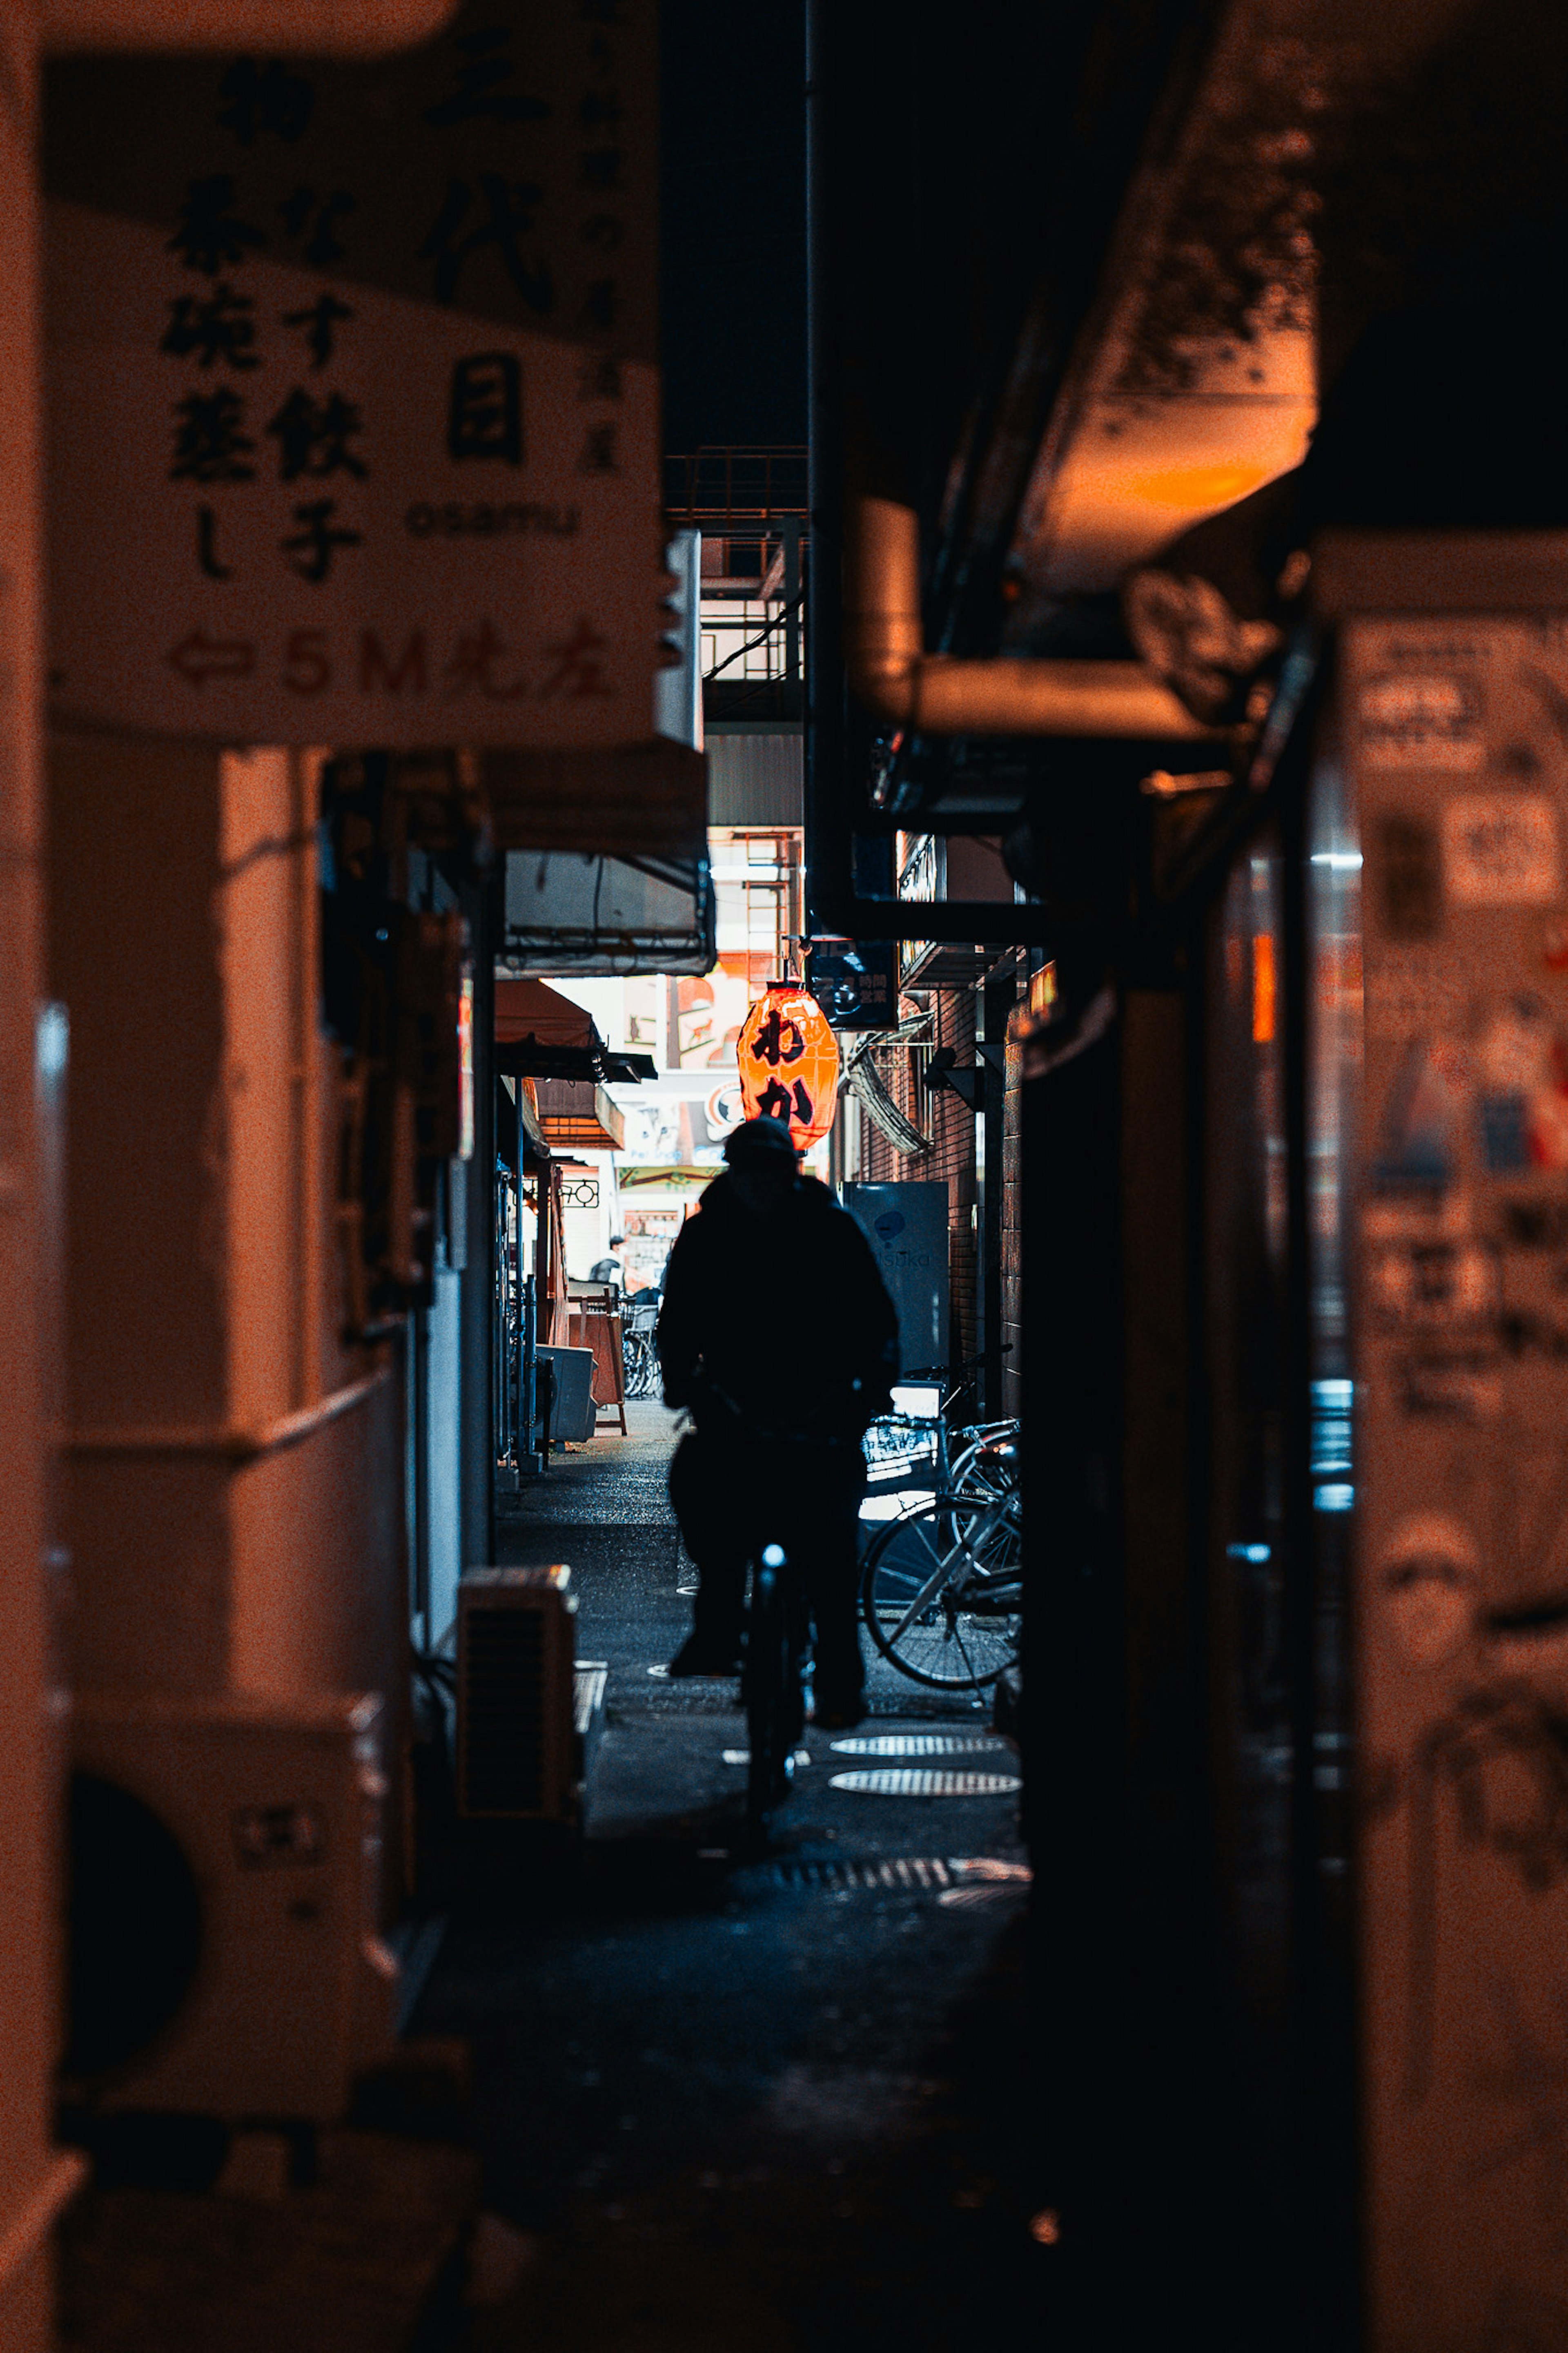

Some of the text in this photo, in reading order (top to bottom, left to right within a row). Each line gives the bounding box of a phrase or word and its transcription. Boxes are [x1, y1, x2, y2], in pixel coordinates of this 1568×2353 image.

[162, 173, 269, 582] 茶碗蒸し
[266, 187, 370, 583] なす餃子
[418, 27, 556, 464] 三代目
[406, 502, 579, 538] osamu
[858, 973, 887, 989] 時間
